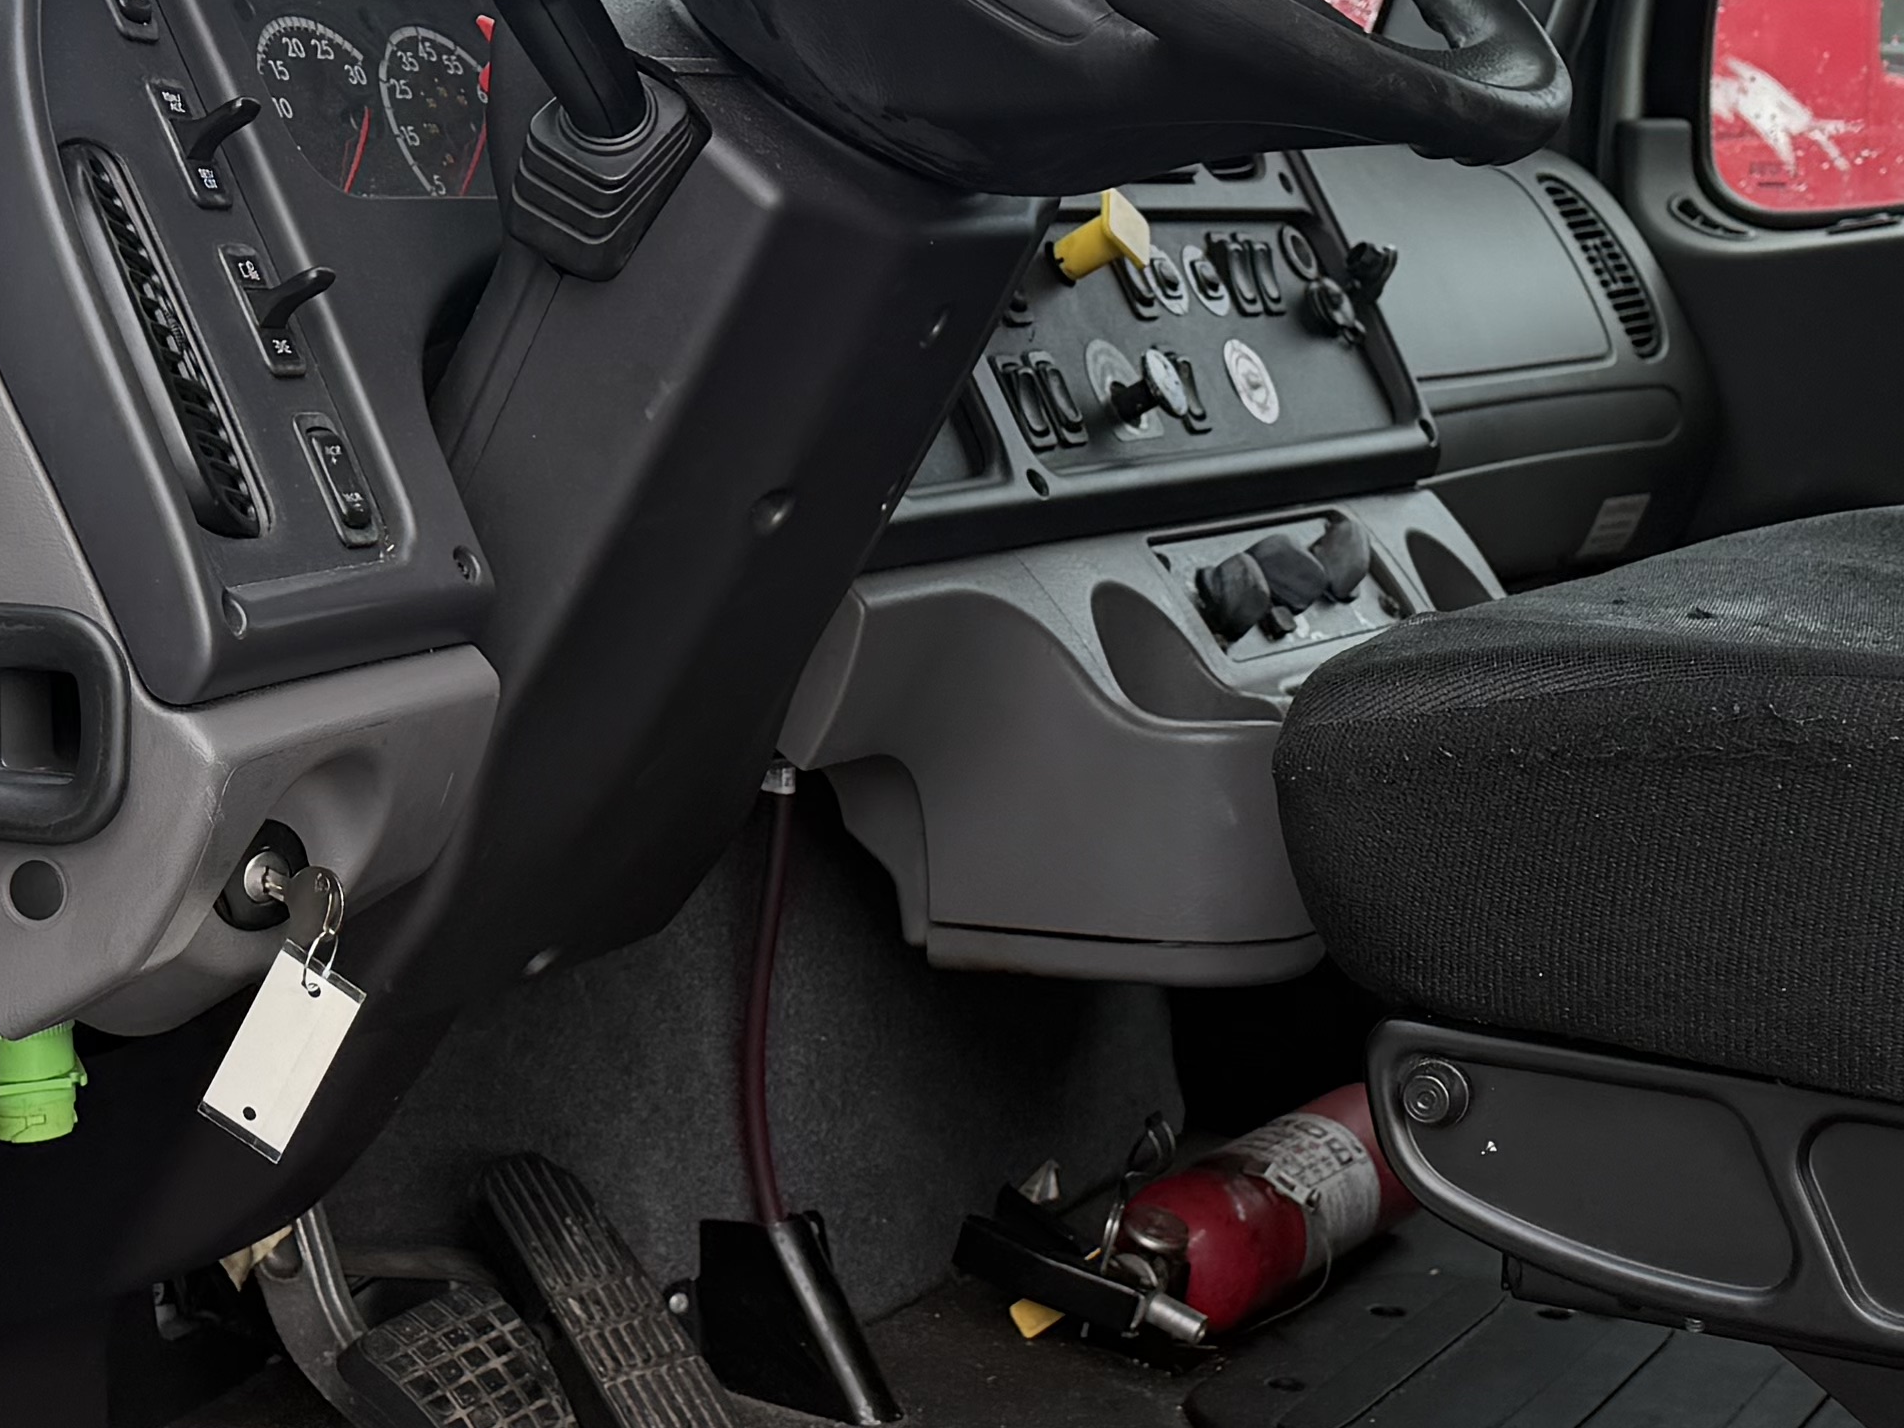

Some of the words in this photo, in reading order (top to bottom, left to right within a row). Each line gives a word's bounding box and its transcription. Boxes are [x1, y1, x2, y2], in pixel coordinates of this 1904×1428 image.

[282, 37, 306, 58] 20
[311, 39, 335, 60] 25
[418, 41, 437, 62] 45
[268, 60, 290, 81] 15
[397, 52, 419, 72] 35
[442, 55, 464, 75] 55
[344, 64, 367, 86] 30
[390, 79, 413, 99] 25
[271, 97, 293, 119] 10
[400, 126, 420, 146] 15
[433, 174, 446, 195] 5
